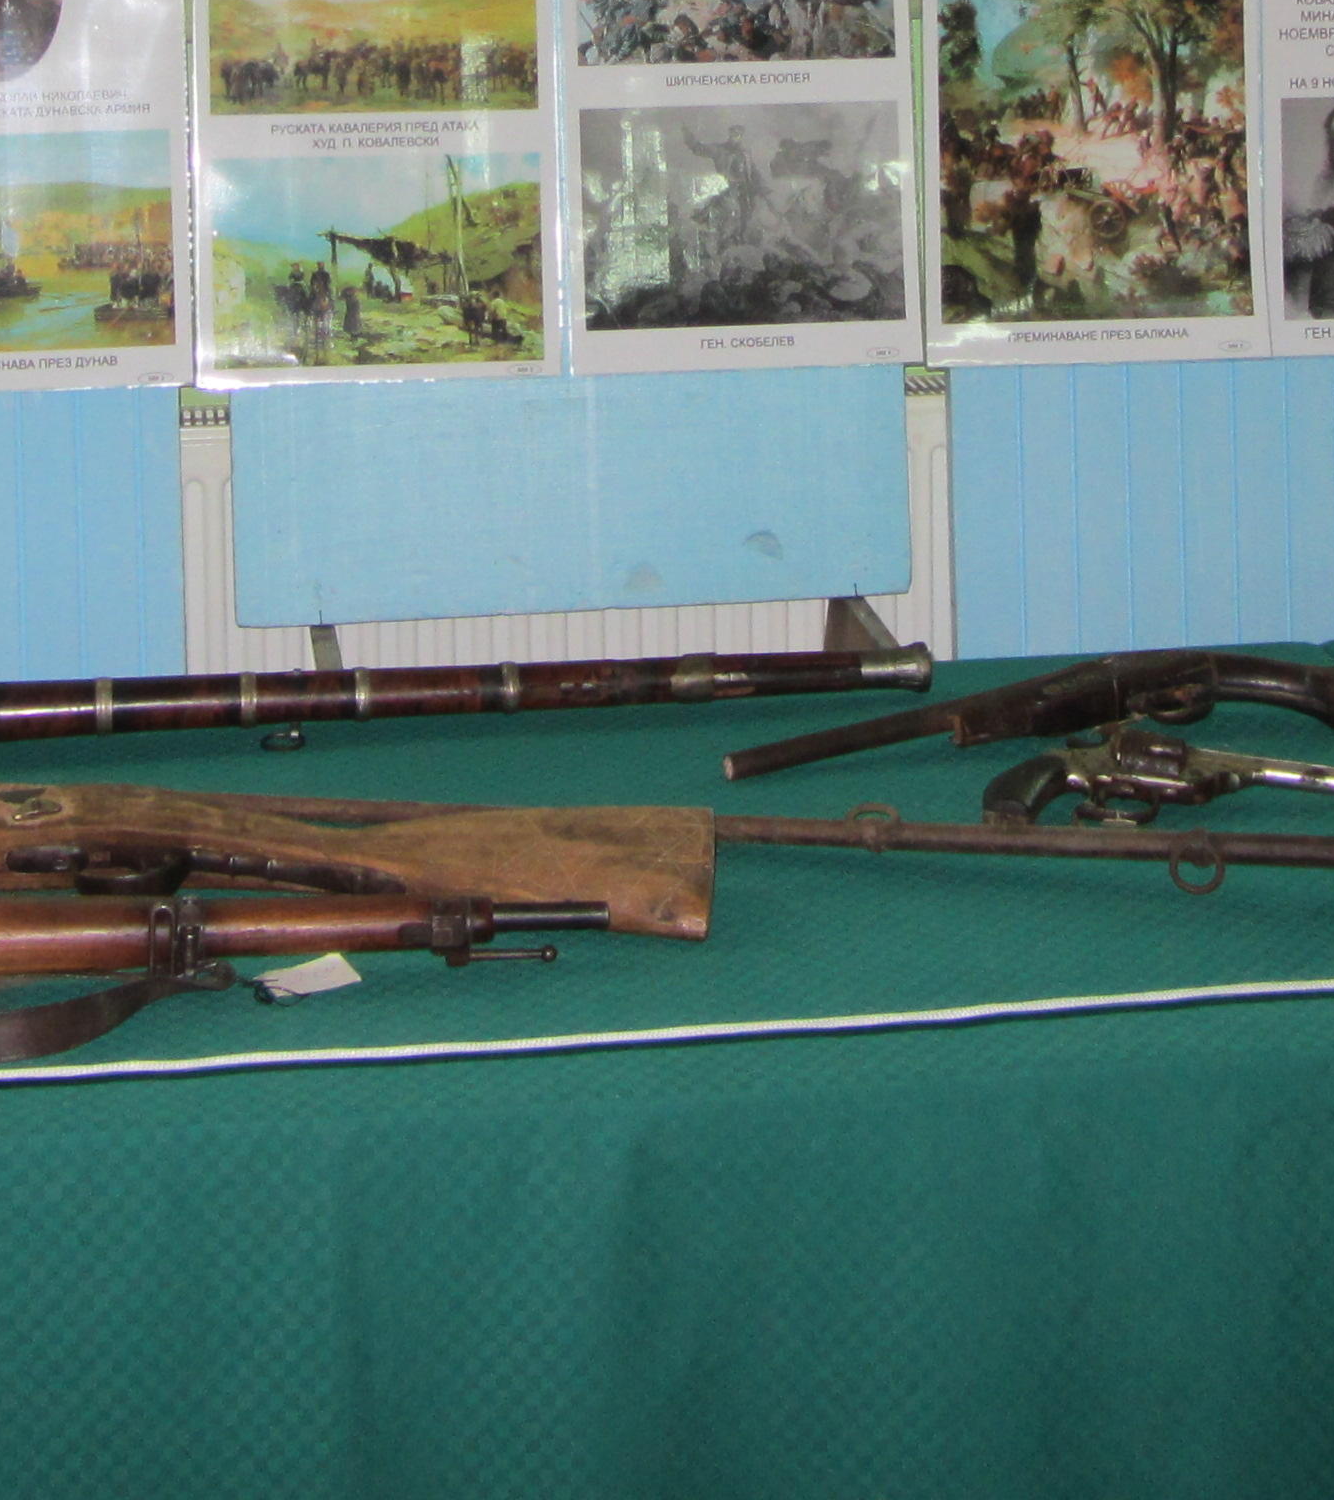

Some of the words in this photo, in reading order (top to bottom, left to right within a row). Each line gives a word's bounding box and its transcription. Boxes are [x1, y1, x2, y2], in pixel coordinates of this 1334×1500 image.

[665, 73, 757, 86] ШИПЧЕНСКАТА
[759, 72, 810, 84] ЕПОПЕЯ
[270, 123, 325, 134] РУСКАТА
[328, 121, 402, 133] КАВАЛЕРИЯ
[404, 121, 438, 133] ПРЕД
[441, 120, 480, 131] АТАКА
[1100, 329, 1131, 340] ПРЕЗ
[1134, 328, 1188, 339] БАЛКАНА
[729, 335, 794, 348] СКОБЕЛЕВ
[38, 357, 71, 369] ПРЕЗ
[74, 355, 117, 369] ДУНАВ
